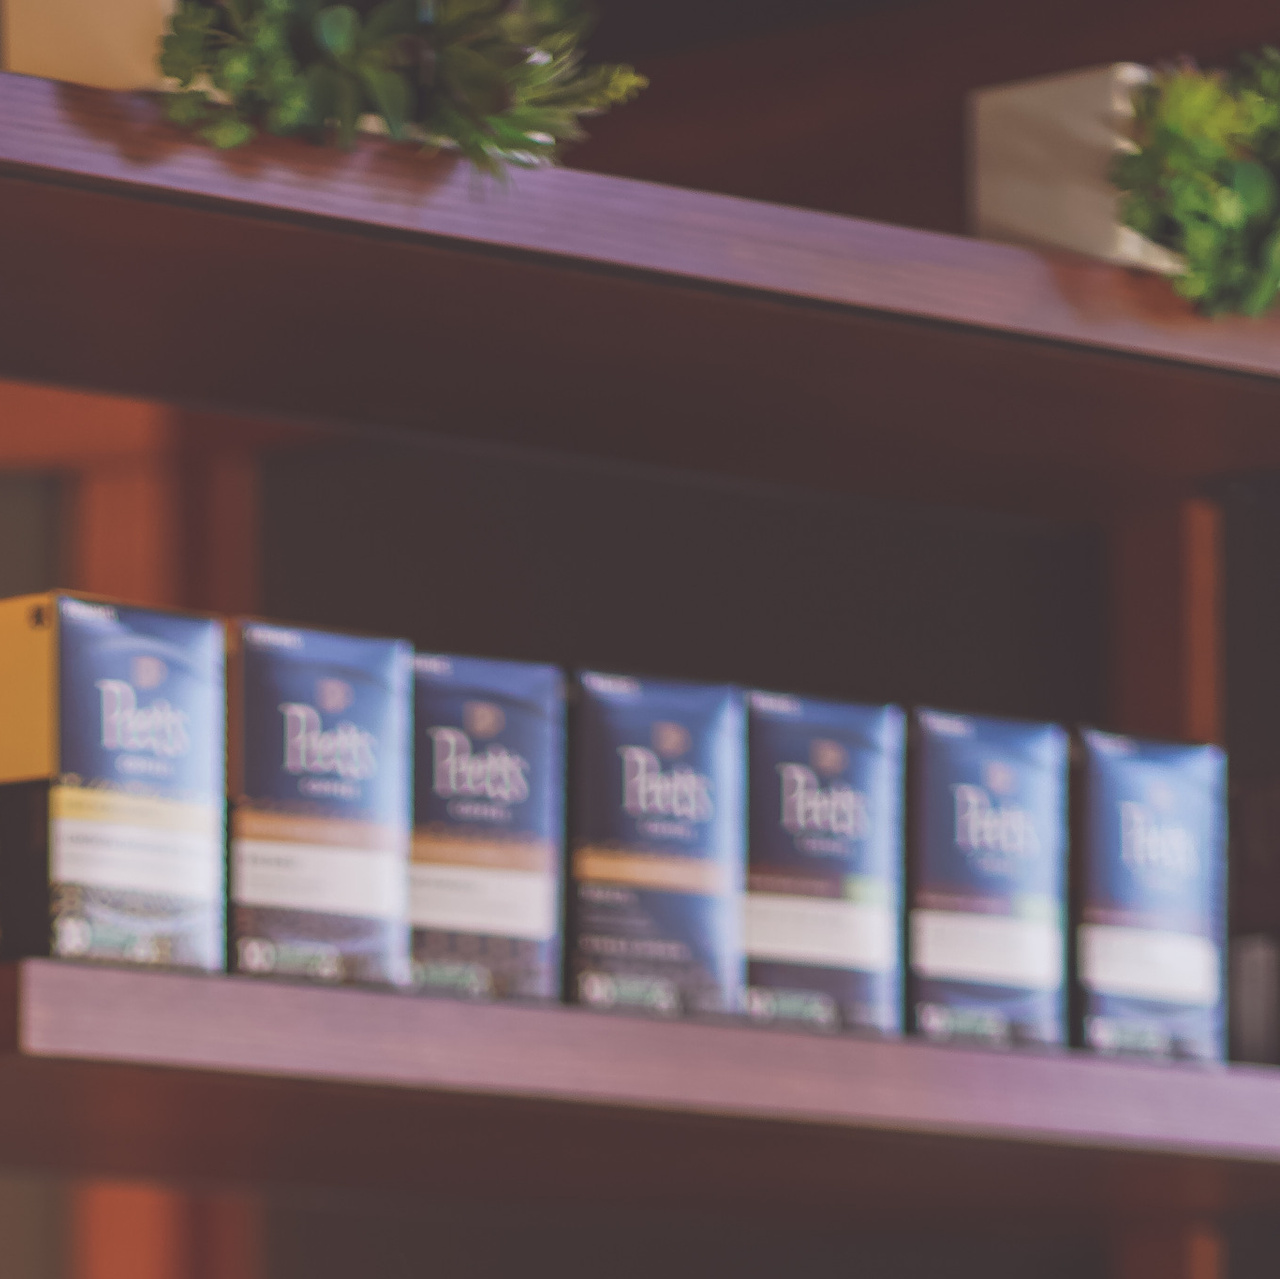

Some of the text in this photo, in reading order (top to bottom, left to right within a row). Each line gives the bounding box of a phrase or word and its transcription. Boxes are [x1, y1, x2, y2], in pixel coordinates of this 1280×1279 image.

[277, 702, 376, 780] Peet's
[427, 726, 530, 803] Peet's
[618, 745, 714, 822] Peet's
